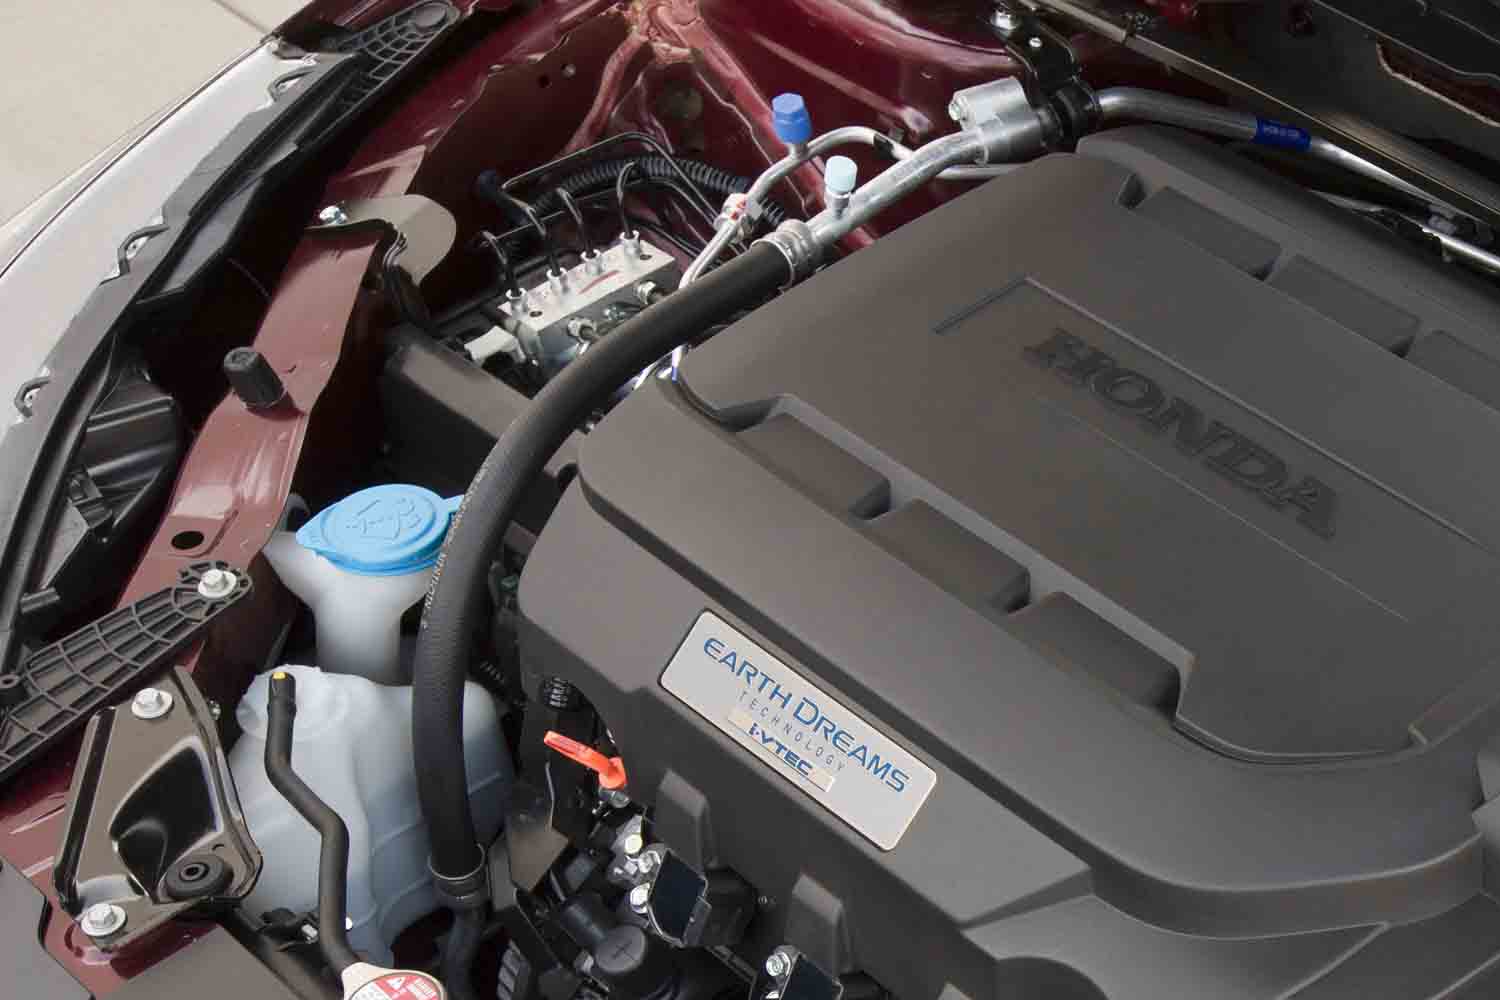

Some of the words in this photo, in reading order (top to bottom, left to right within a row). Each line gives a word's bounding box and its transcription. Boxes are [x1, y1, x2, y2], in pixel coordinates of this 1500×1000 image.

[1022, 327, 1341, 541] HONDA
[702, 636, 794, 710] EARTH
[792, 697, 912, 793] DREAMS
[739, 691, 847, 772] TECHNOLOGY
